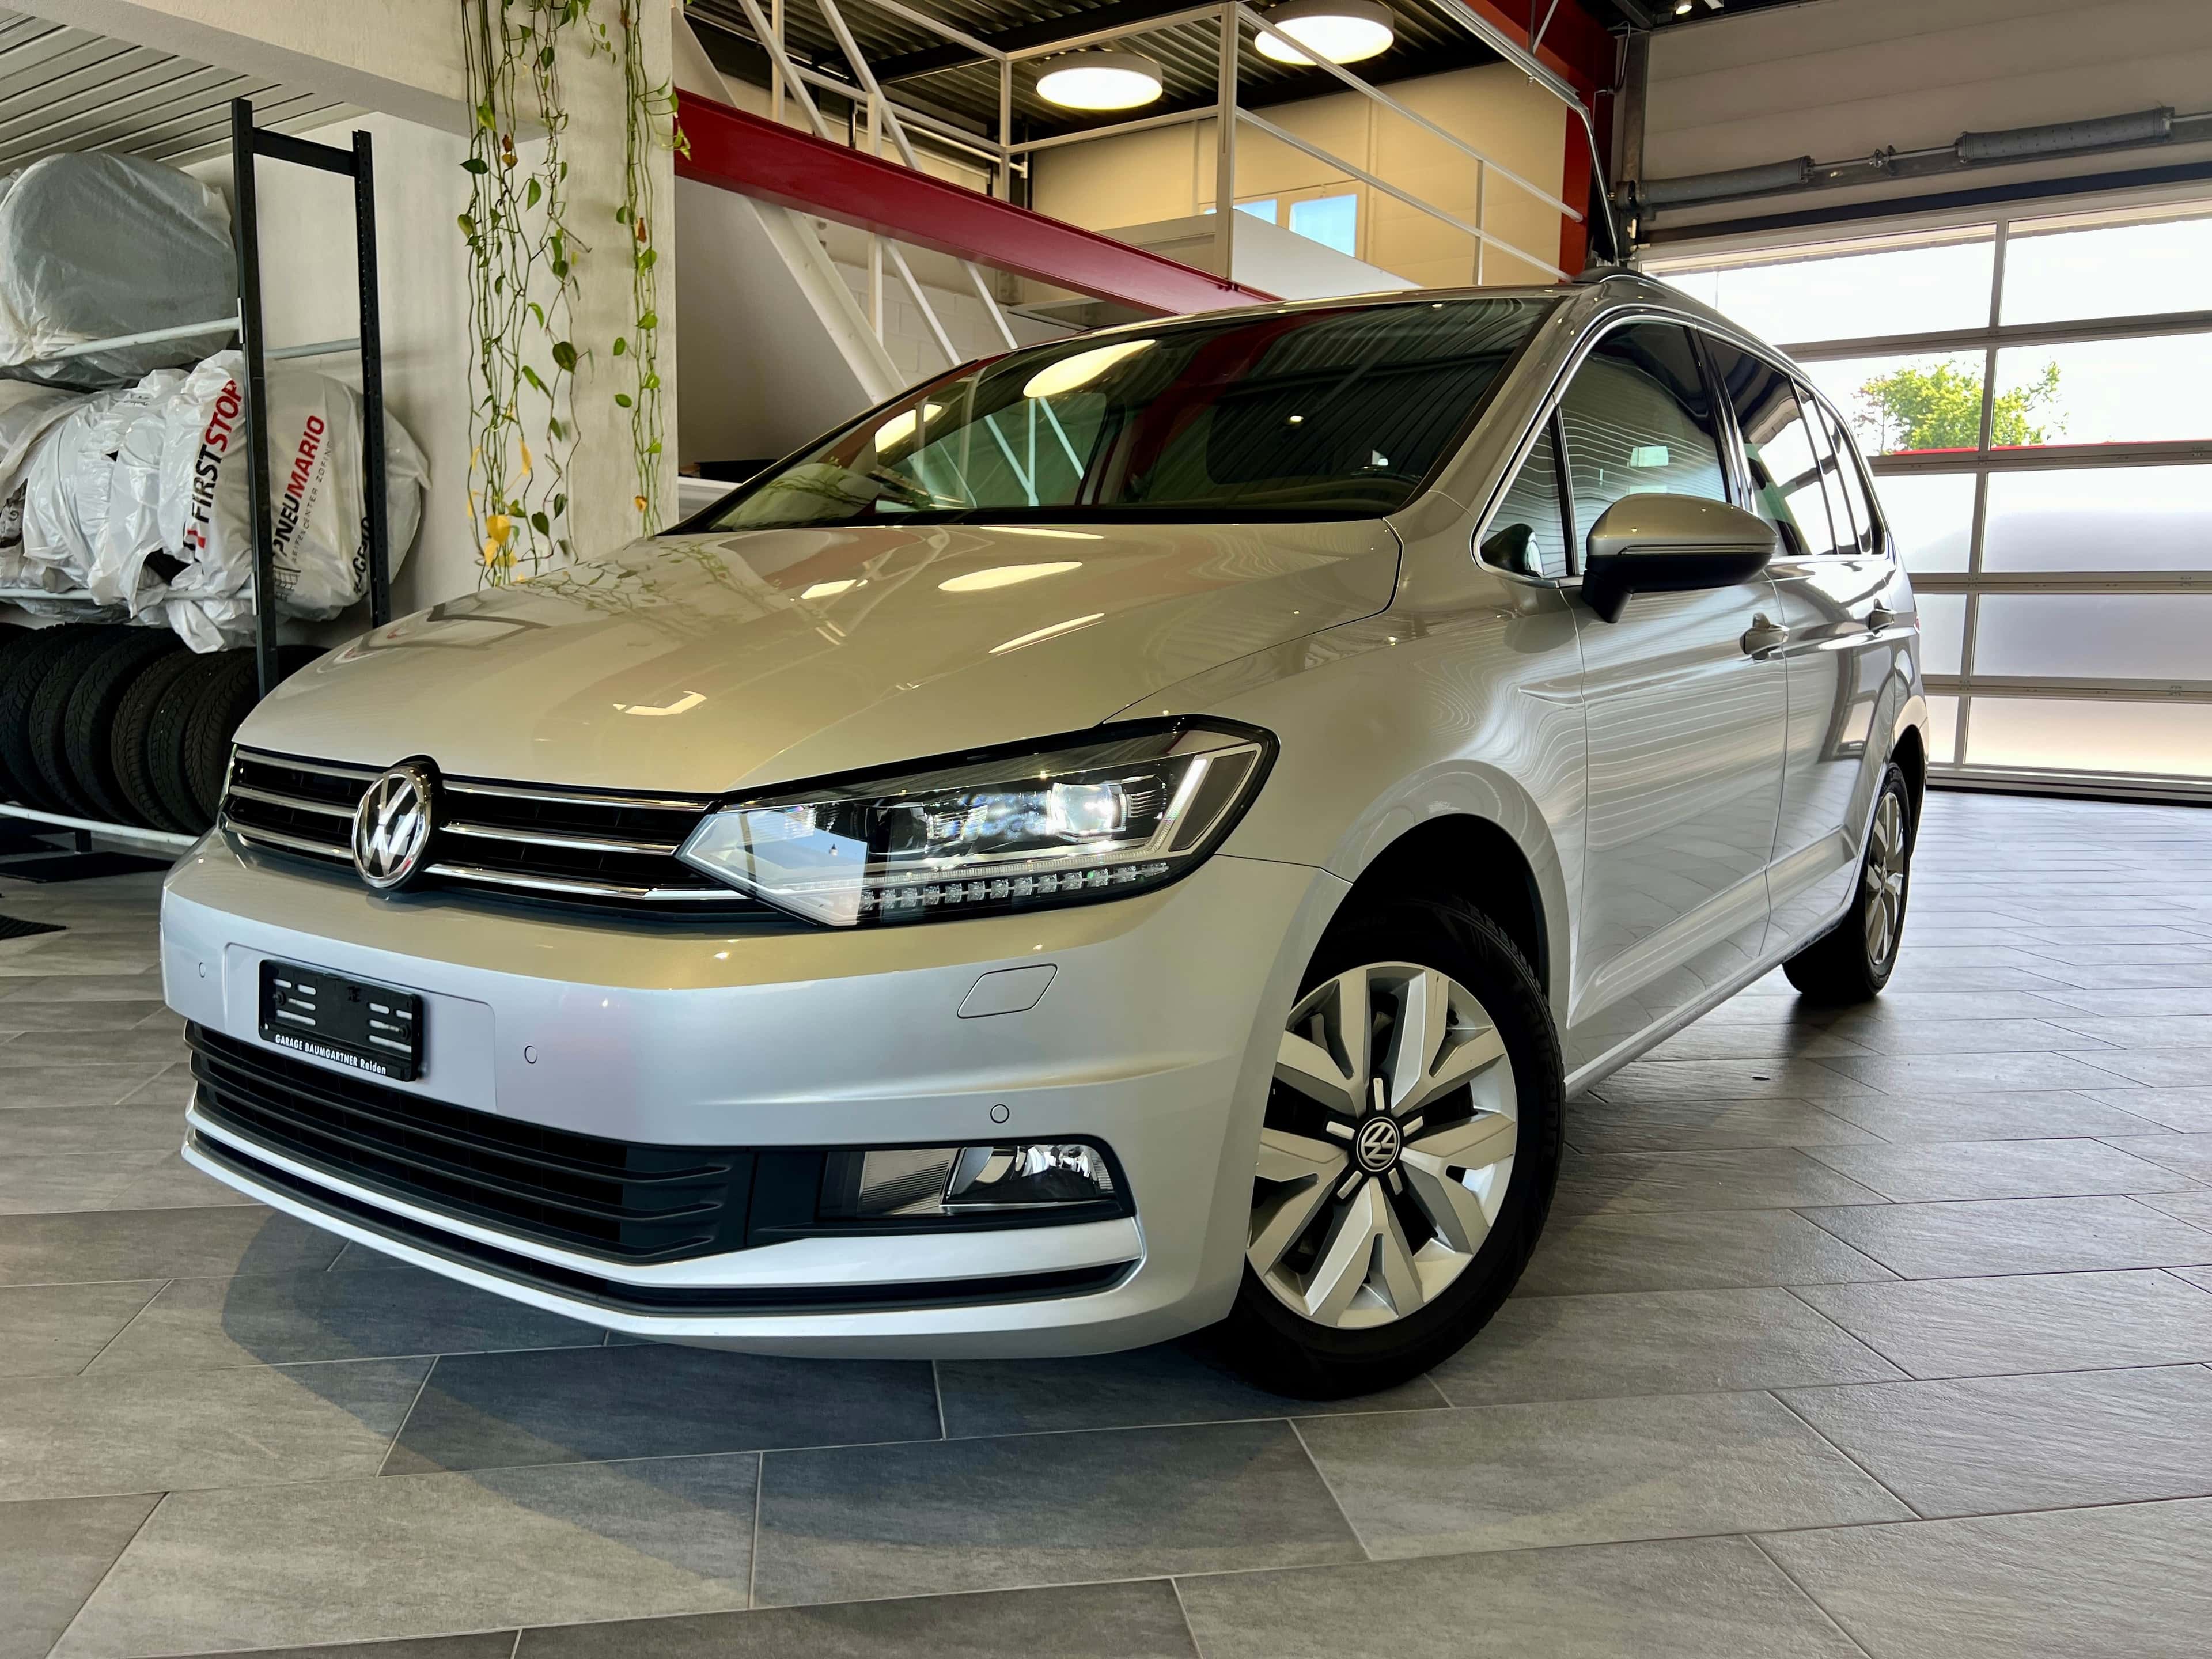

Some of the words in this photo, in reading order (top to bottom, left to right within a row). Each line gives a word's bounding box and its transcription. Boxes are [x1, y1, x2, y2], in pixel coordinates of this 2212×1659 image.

[275, 1034, 303, 1050] GARAGE
[304, 1043, 358, 1066] BAUMGARTNER
[360, 1059, 387, 1075] Reiden
